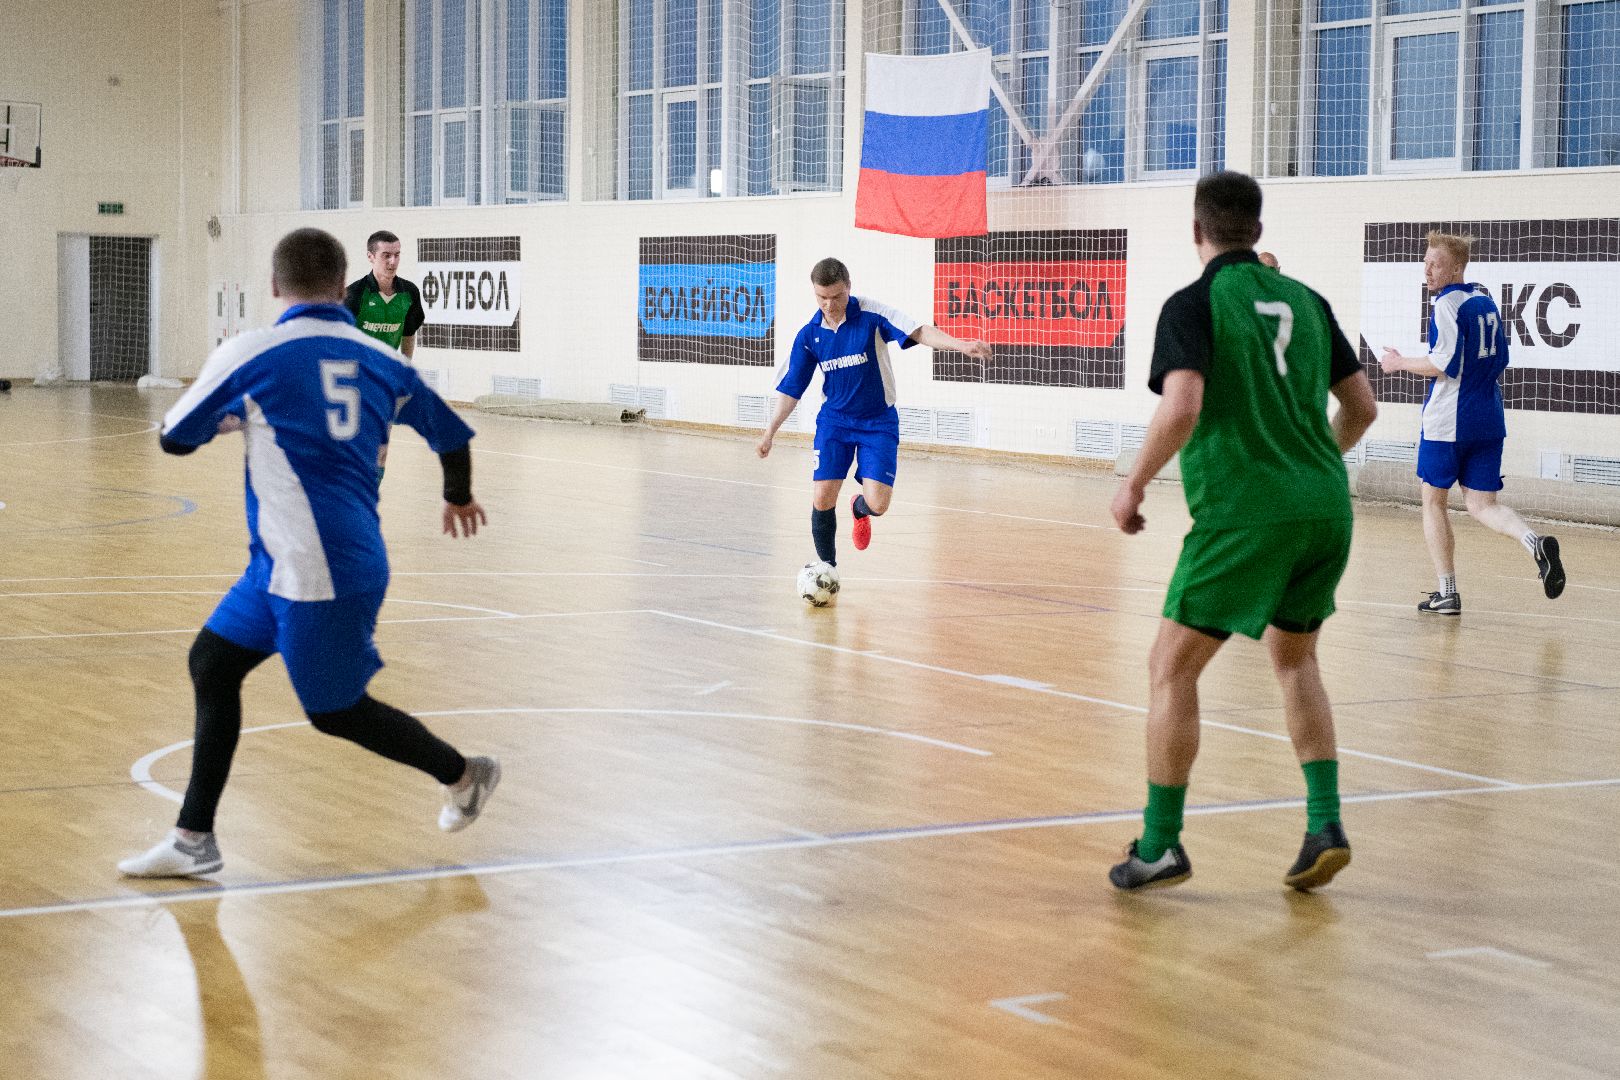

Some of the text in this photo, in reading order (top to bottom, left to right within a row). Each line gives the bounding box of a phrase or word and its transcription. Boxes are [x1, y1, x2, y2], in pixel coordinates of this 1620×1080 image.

[422, 270, 510, 311] ФУТБОЛ
[645, 279, 766, 323] ВОЛЕЙБОЛ
[948, 281, 1113, 320] БАСКЕТБОЛ
[1253, 300, 1294, 377] 7
[1420, 282, 1582, 348] КС
[1477, 312, 1499, 359] 17
[319, 359, 361, 441] 5
